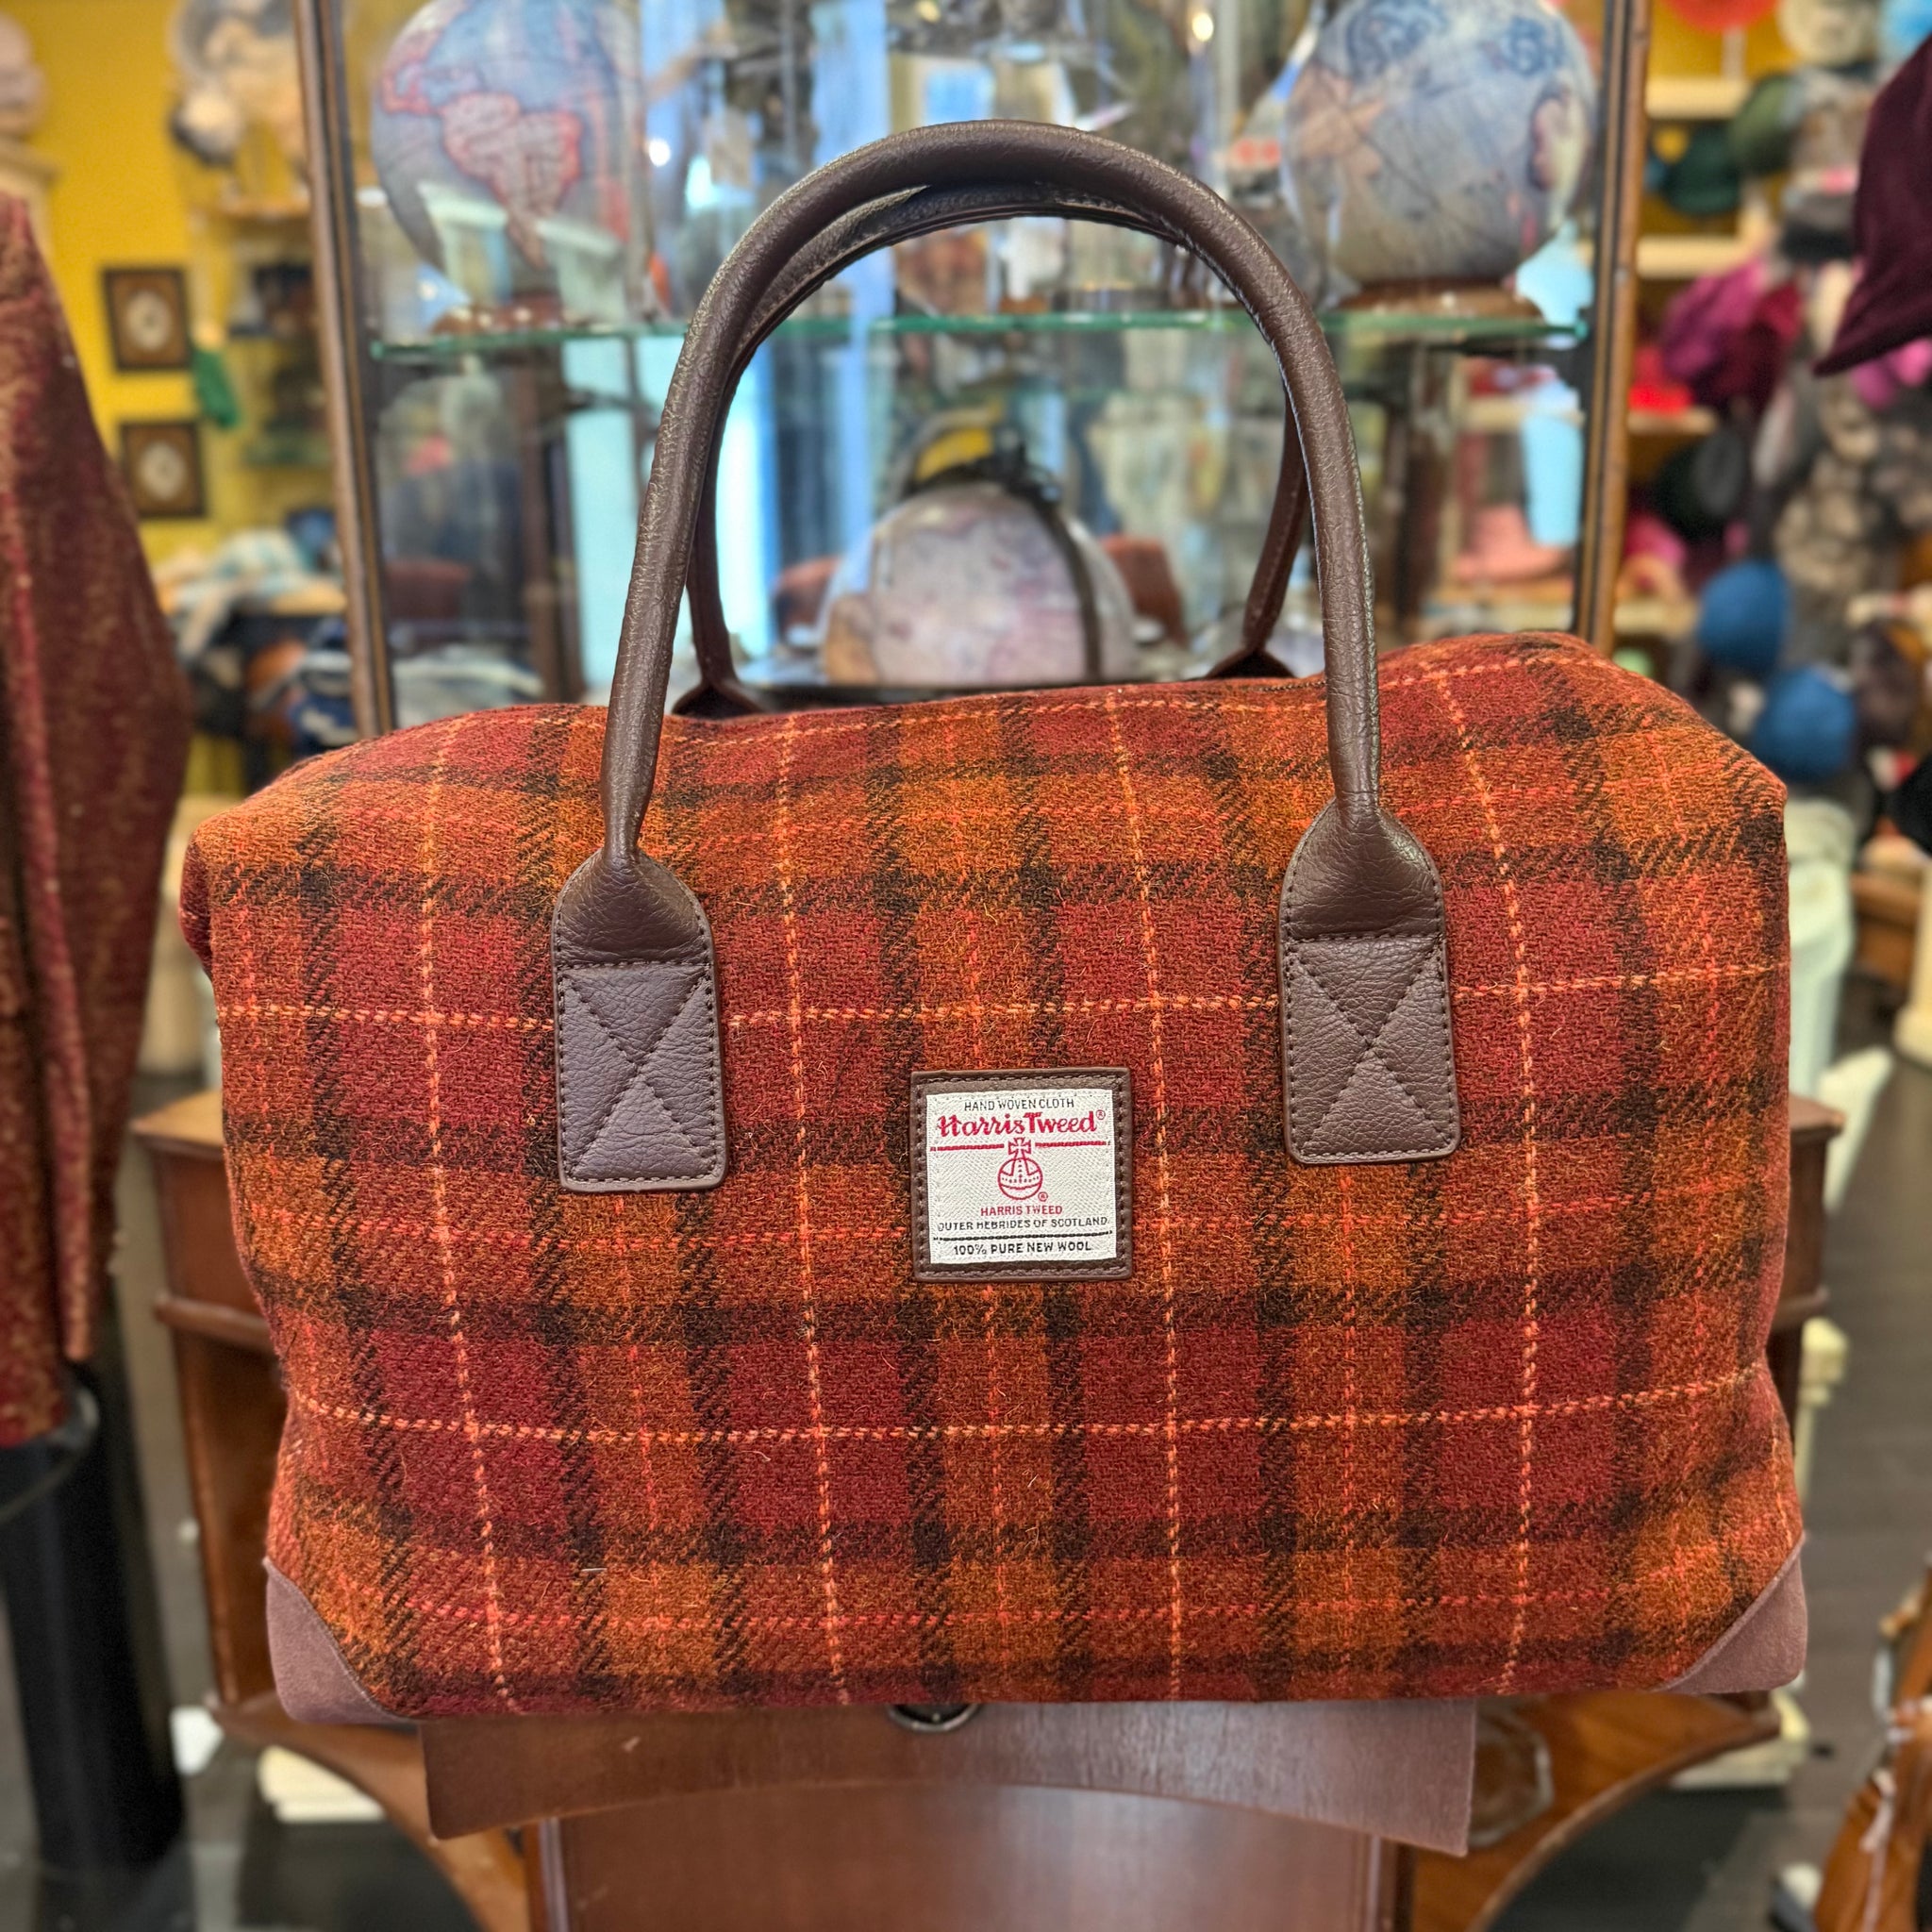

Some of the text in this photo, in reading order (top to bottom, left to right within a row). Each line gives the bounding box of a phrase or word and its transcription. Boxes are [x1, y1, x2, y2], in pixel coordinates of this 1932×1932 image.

[964, 1098, 1074, 1111] HAND WOVEN CLOTH
[980, 1205, 1063, 1217] HARRIS TWEED
[938, 1217, 1108, 1232] OUTER HEBRIDES OF SCOTLAND
[954, 1241, 1091, 1256] 100% PURE NEW WOOL
